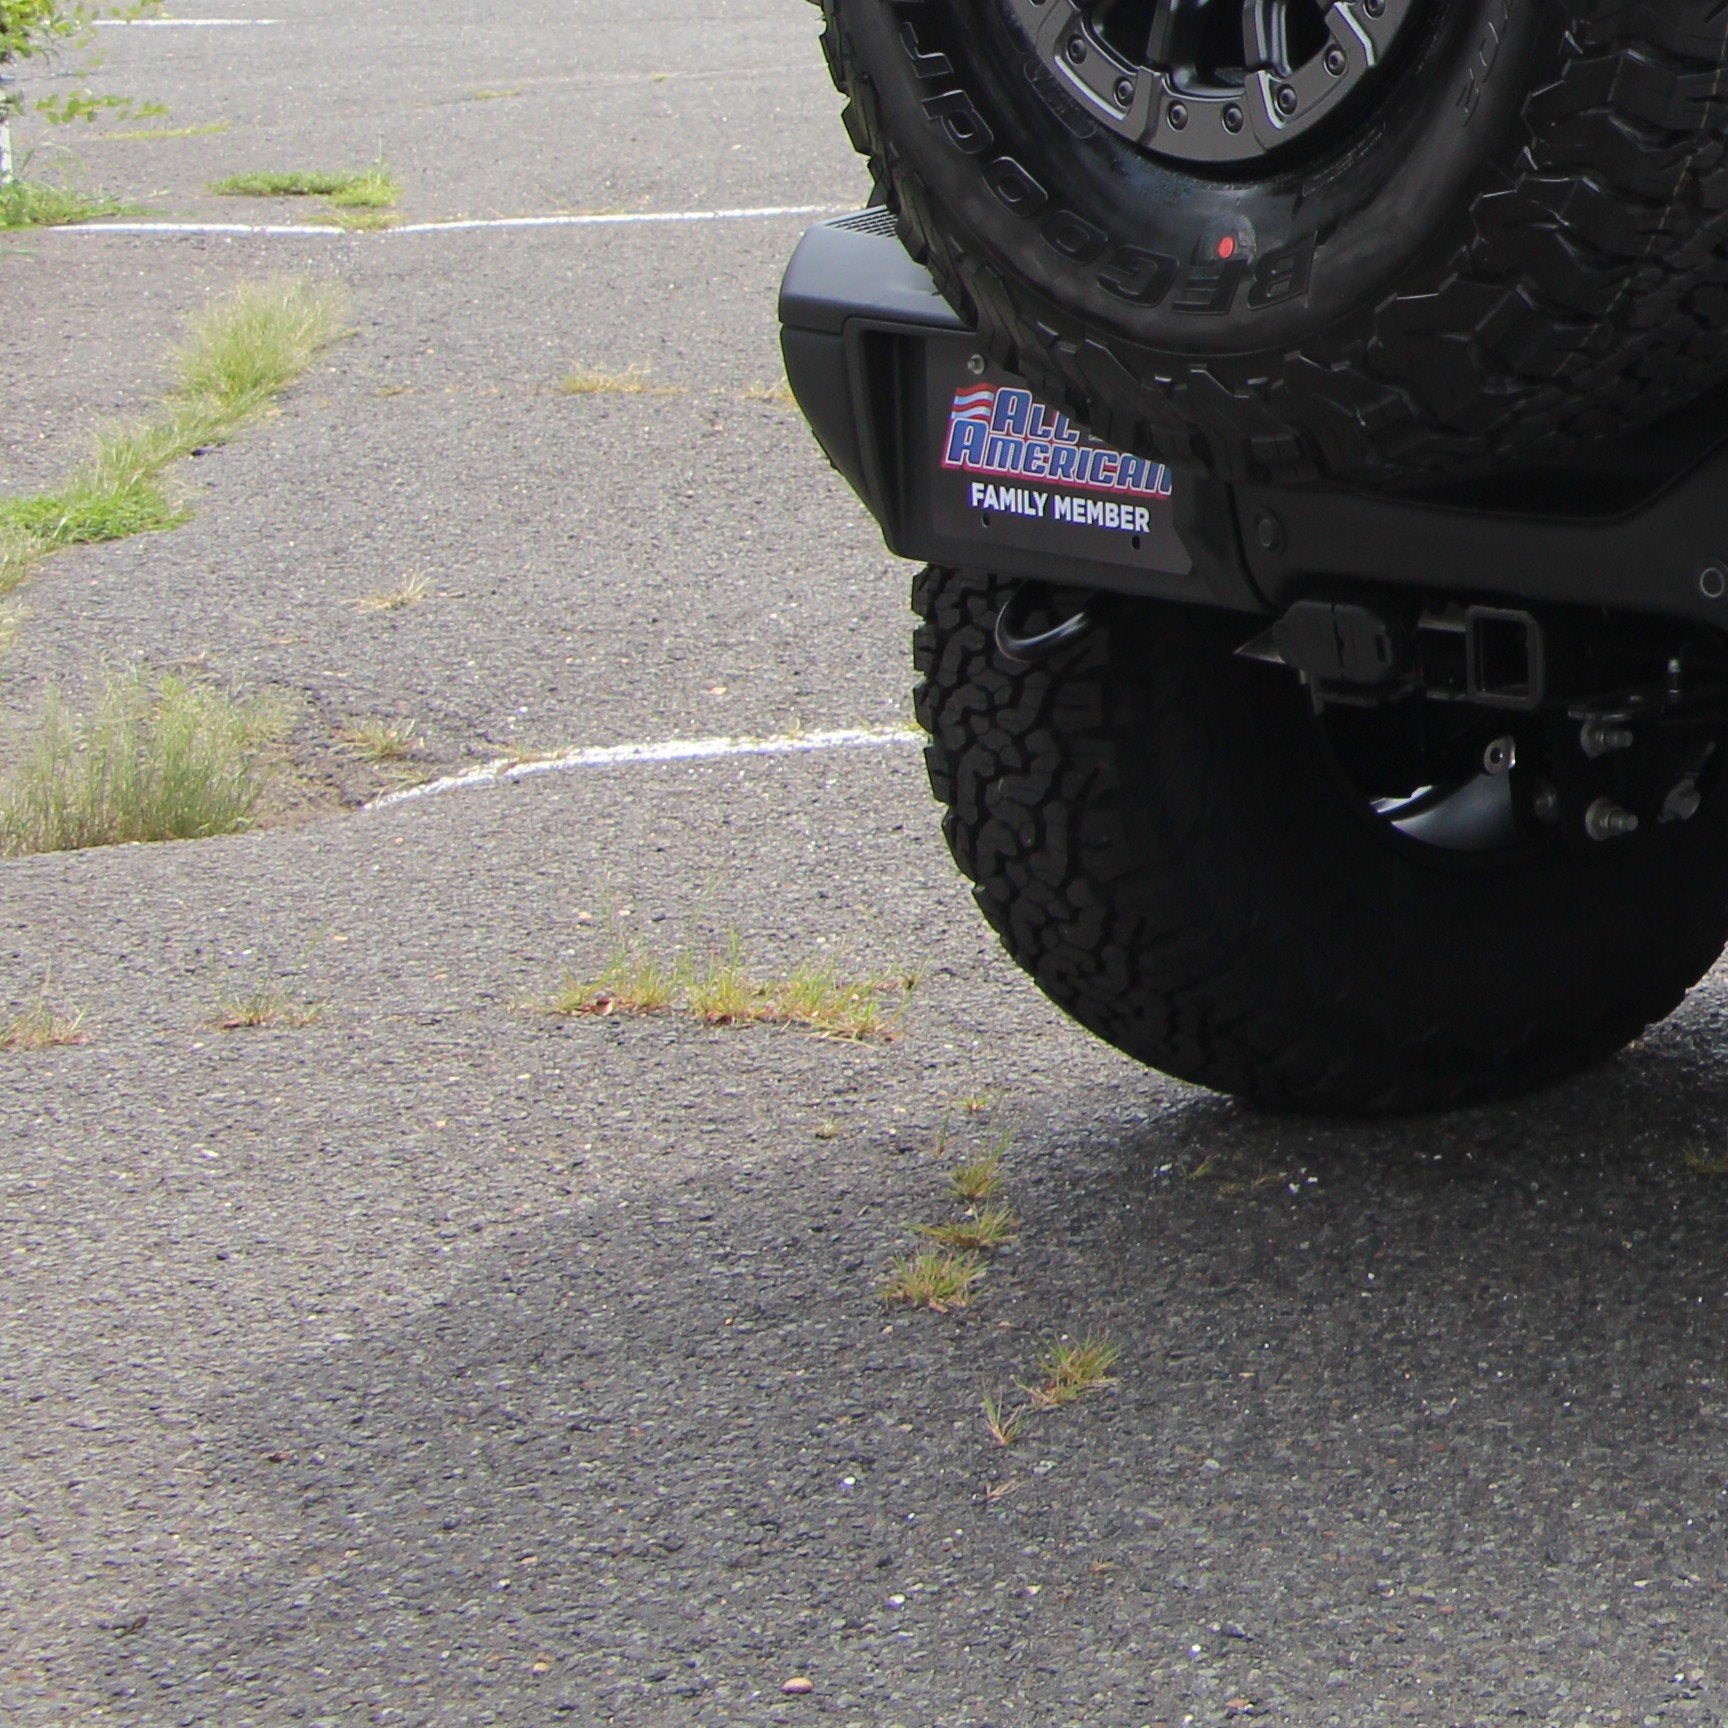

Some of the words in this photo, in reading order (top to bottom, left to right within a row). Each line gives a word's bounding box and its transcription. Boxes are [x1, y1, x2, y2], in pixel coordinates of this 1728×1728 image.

[990, 386, 1080, 444] ALL
[943, 418, 1173, 496] AMERICAN
[969, 481, 1049, 518] FAMILY
[1052, 493, 1151, 534] MEMBER
